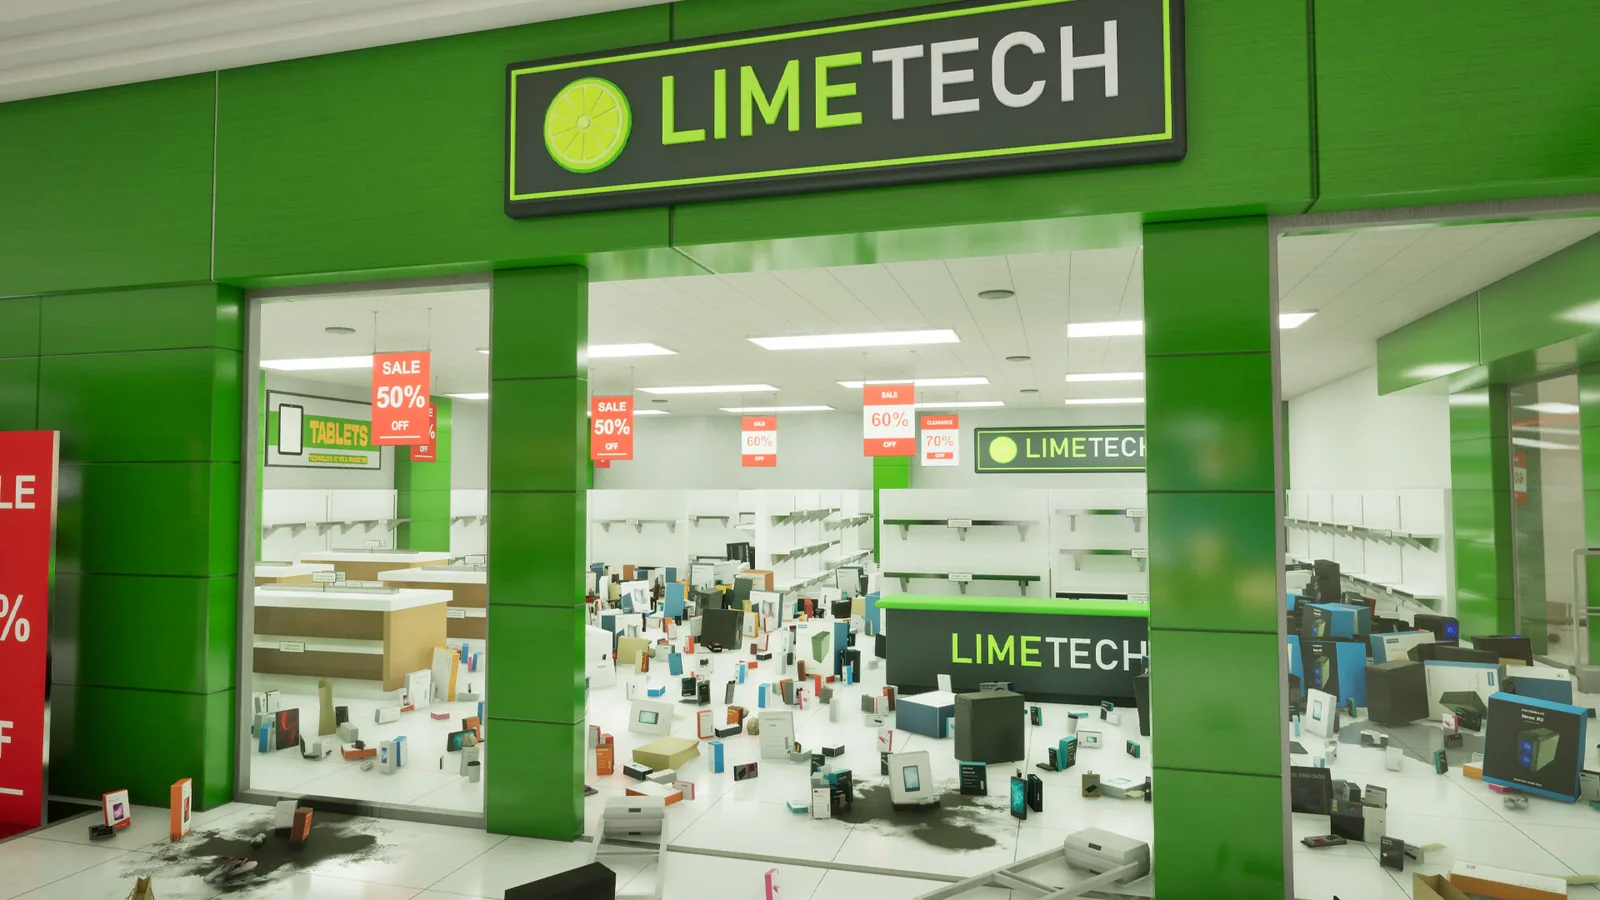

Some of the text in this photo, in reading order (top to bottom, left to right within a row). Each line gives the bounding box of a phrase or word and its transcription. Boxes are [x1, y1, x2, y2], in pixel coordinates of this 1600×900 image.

[661, 20, 1119, 146] LIMETECH
[382, 360, 421, 375] SALE
[376, 384, 426, 409] 50%
[881, 391, 898, 399] SALE
[597, 401, 627, 412] SALE
[391, 420, 410, 431] OFF
[871, 411, 909, 427] 60%
[594, 418, 630, 435] 50%
[309, 420, 368, 447] TABLETS
[605, 442, 619, 451] OFF
[746, 435, 773, 447] 60%
[926, 435, 954, 447] 70%
[419, 445, 429, 453] OFF
[951, 632, 1147, 671] LIMETECH
